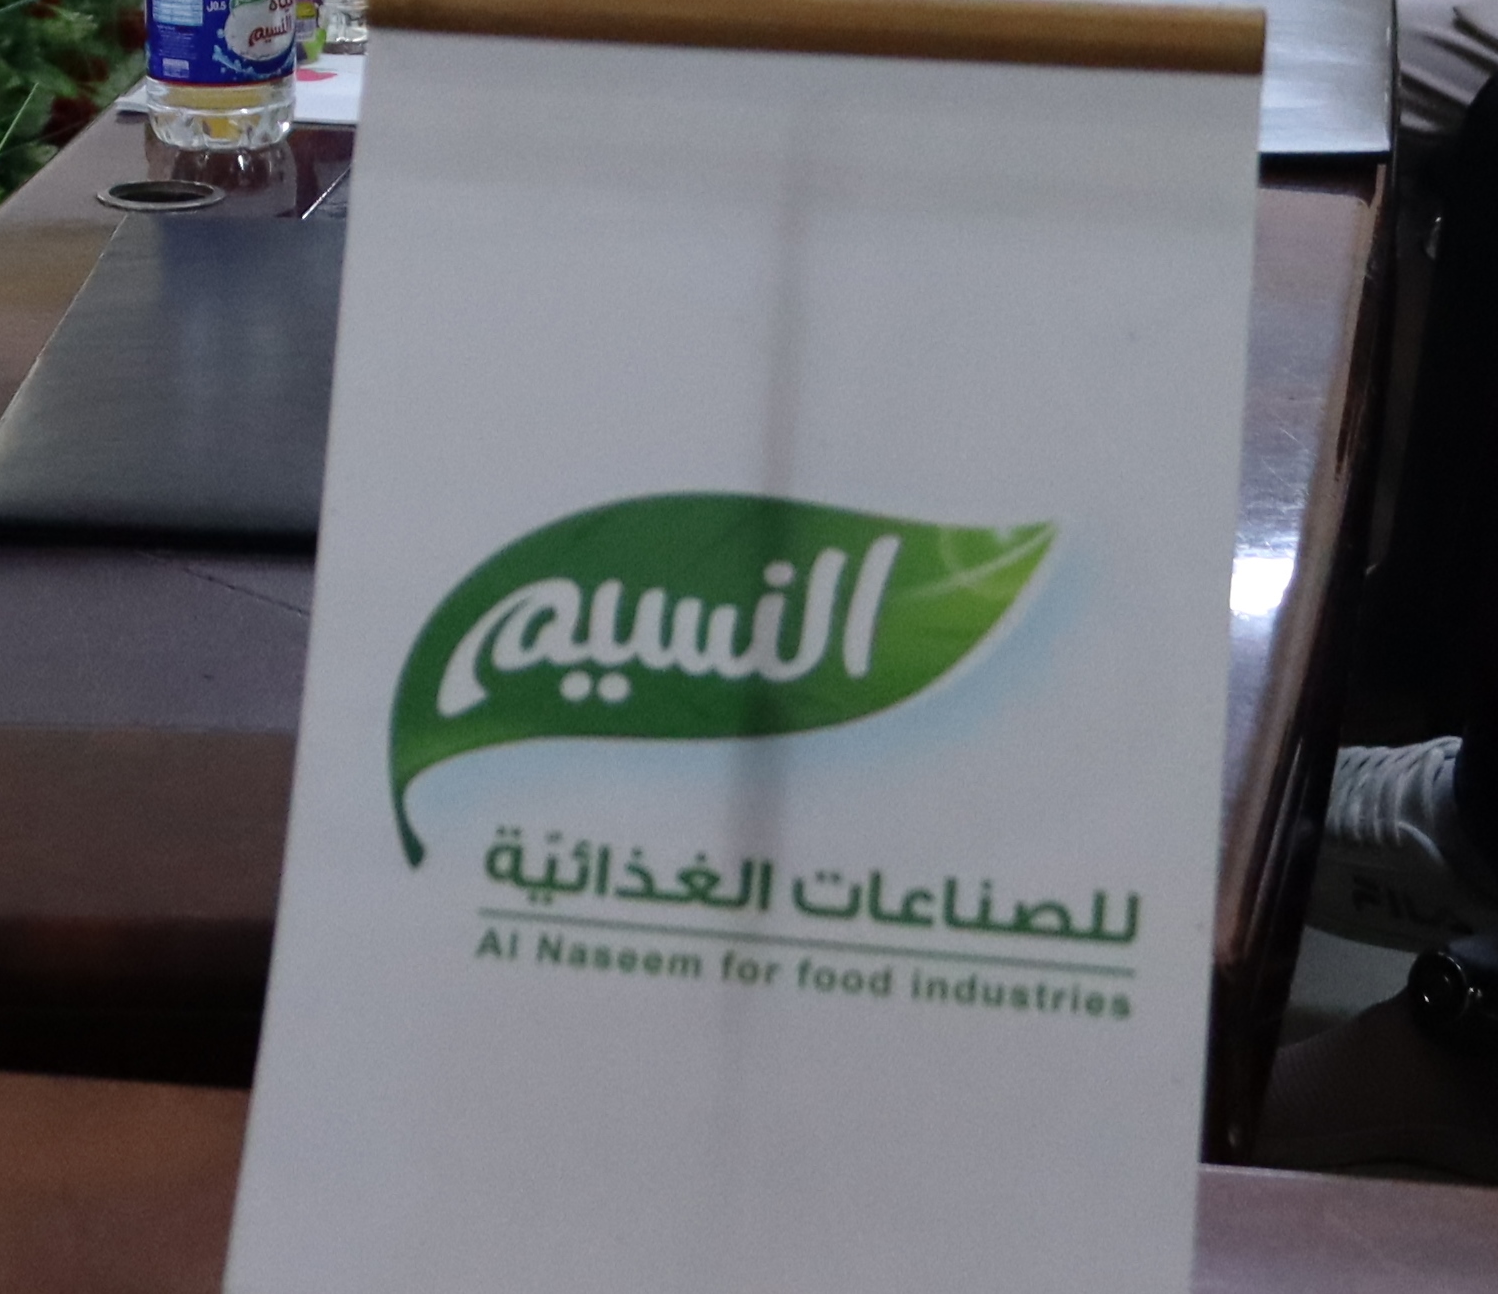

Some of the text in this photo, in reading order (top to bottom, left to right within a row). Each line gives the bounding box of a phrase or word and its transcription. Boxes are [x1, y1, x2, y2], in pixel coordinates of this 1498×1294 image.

[437, 533, 902, 718] النسيم
[790, 868, 1141, 946] للصناعات
[475, 925, 1132, 1019] Al Naseem for food industries
